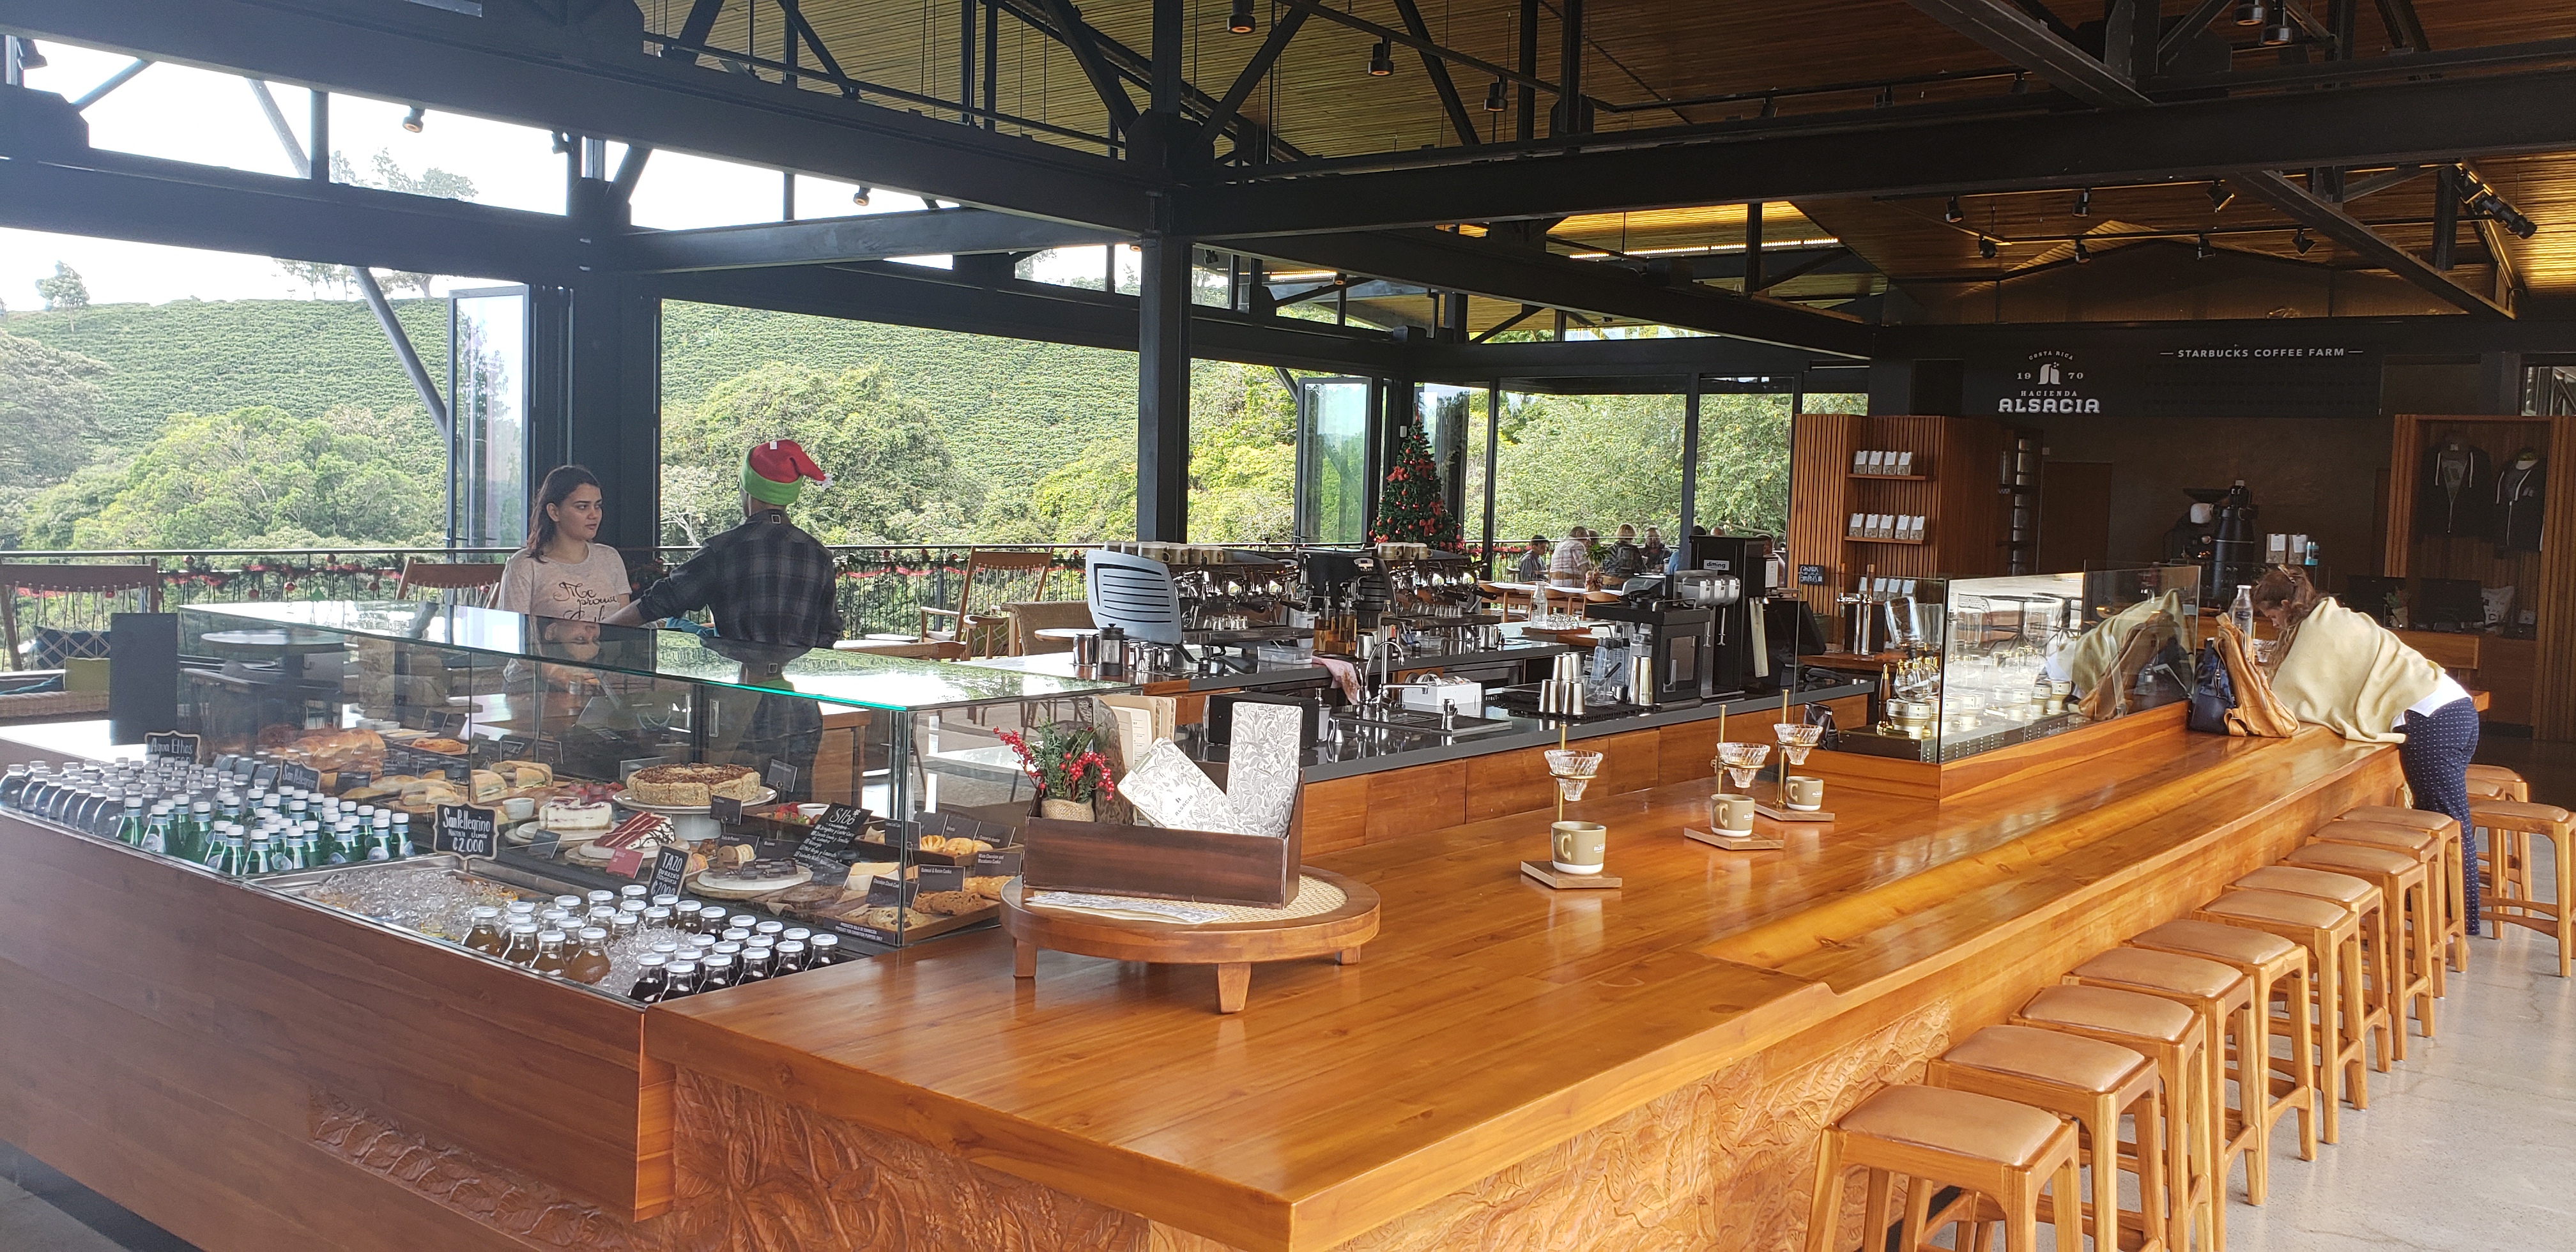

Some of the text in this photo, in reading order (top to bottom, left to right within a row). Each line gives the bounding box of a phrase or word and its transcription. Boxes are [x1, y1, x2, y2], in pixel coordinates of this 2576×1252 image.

[2028, 351, 2073, 360] COSTA RICA
[2178, 348, 2345, 358] STARBUCKS COFFEE FARM
[1998, 398, 2100, 413] ALSACIA
[1175, 795, 1193, 816] ALSACIA
[663, 852, 683, 872] TAZO
